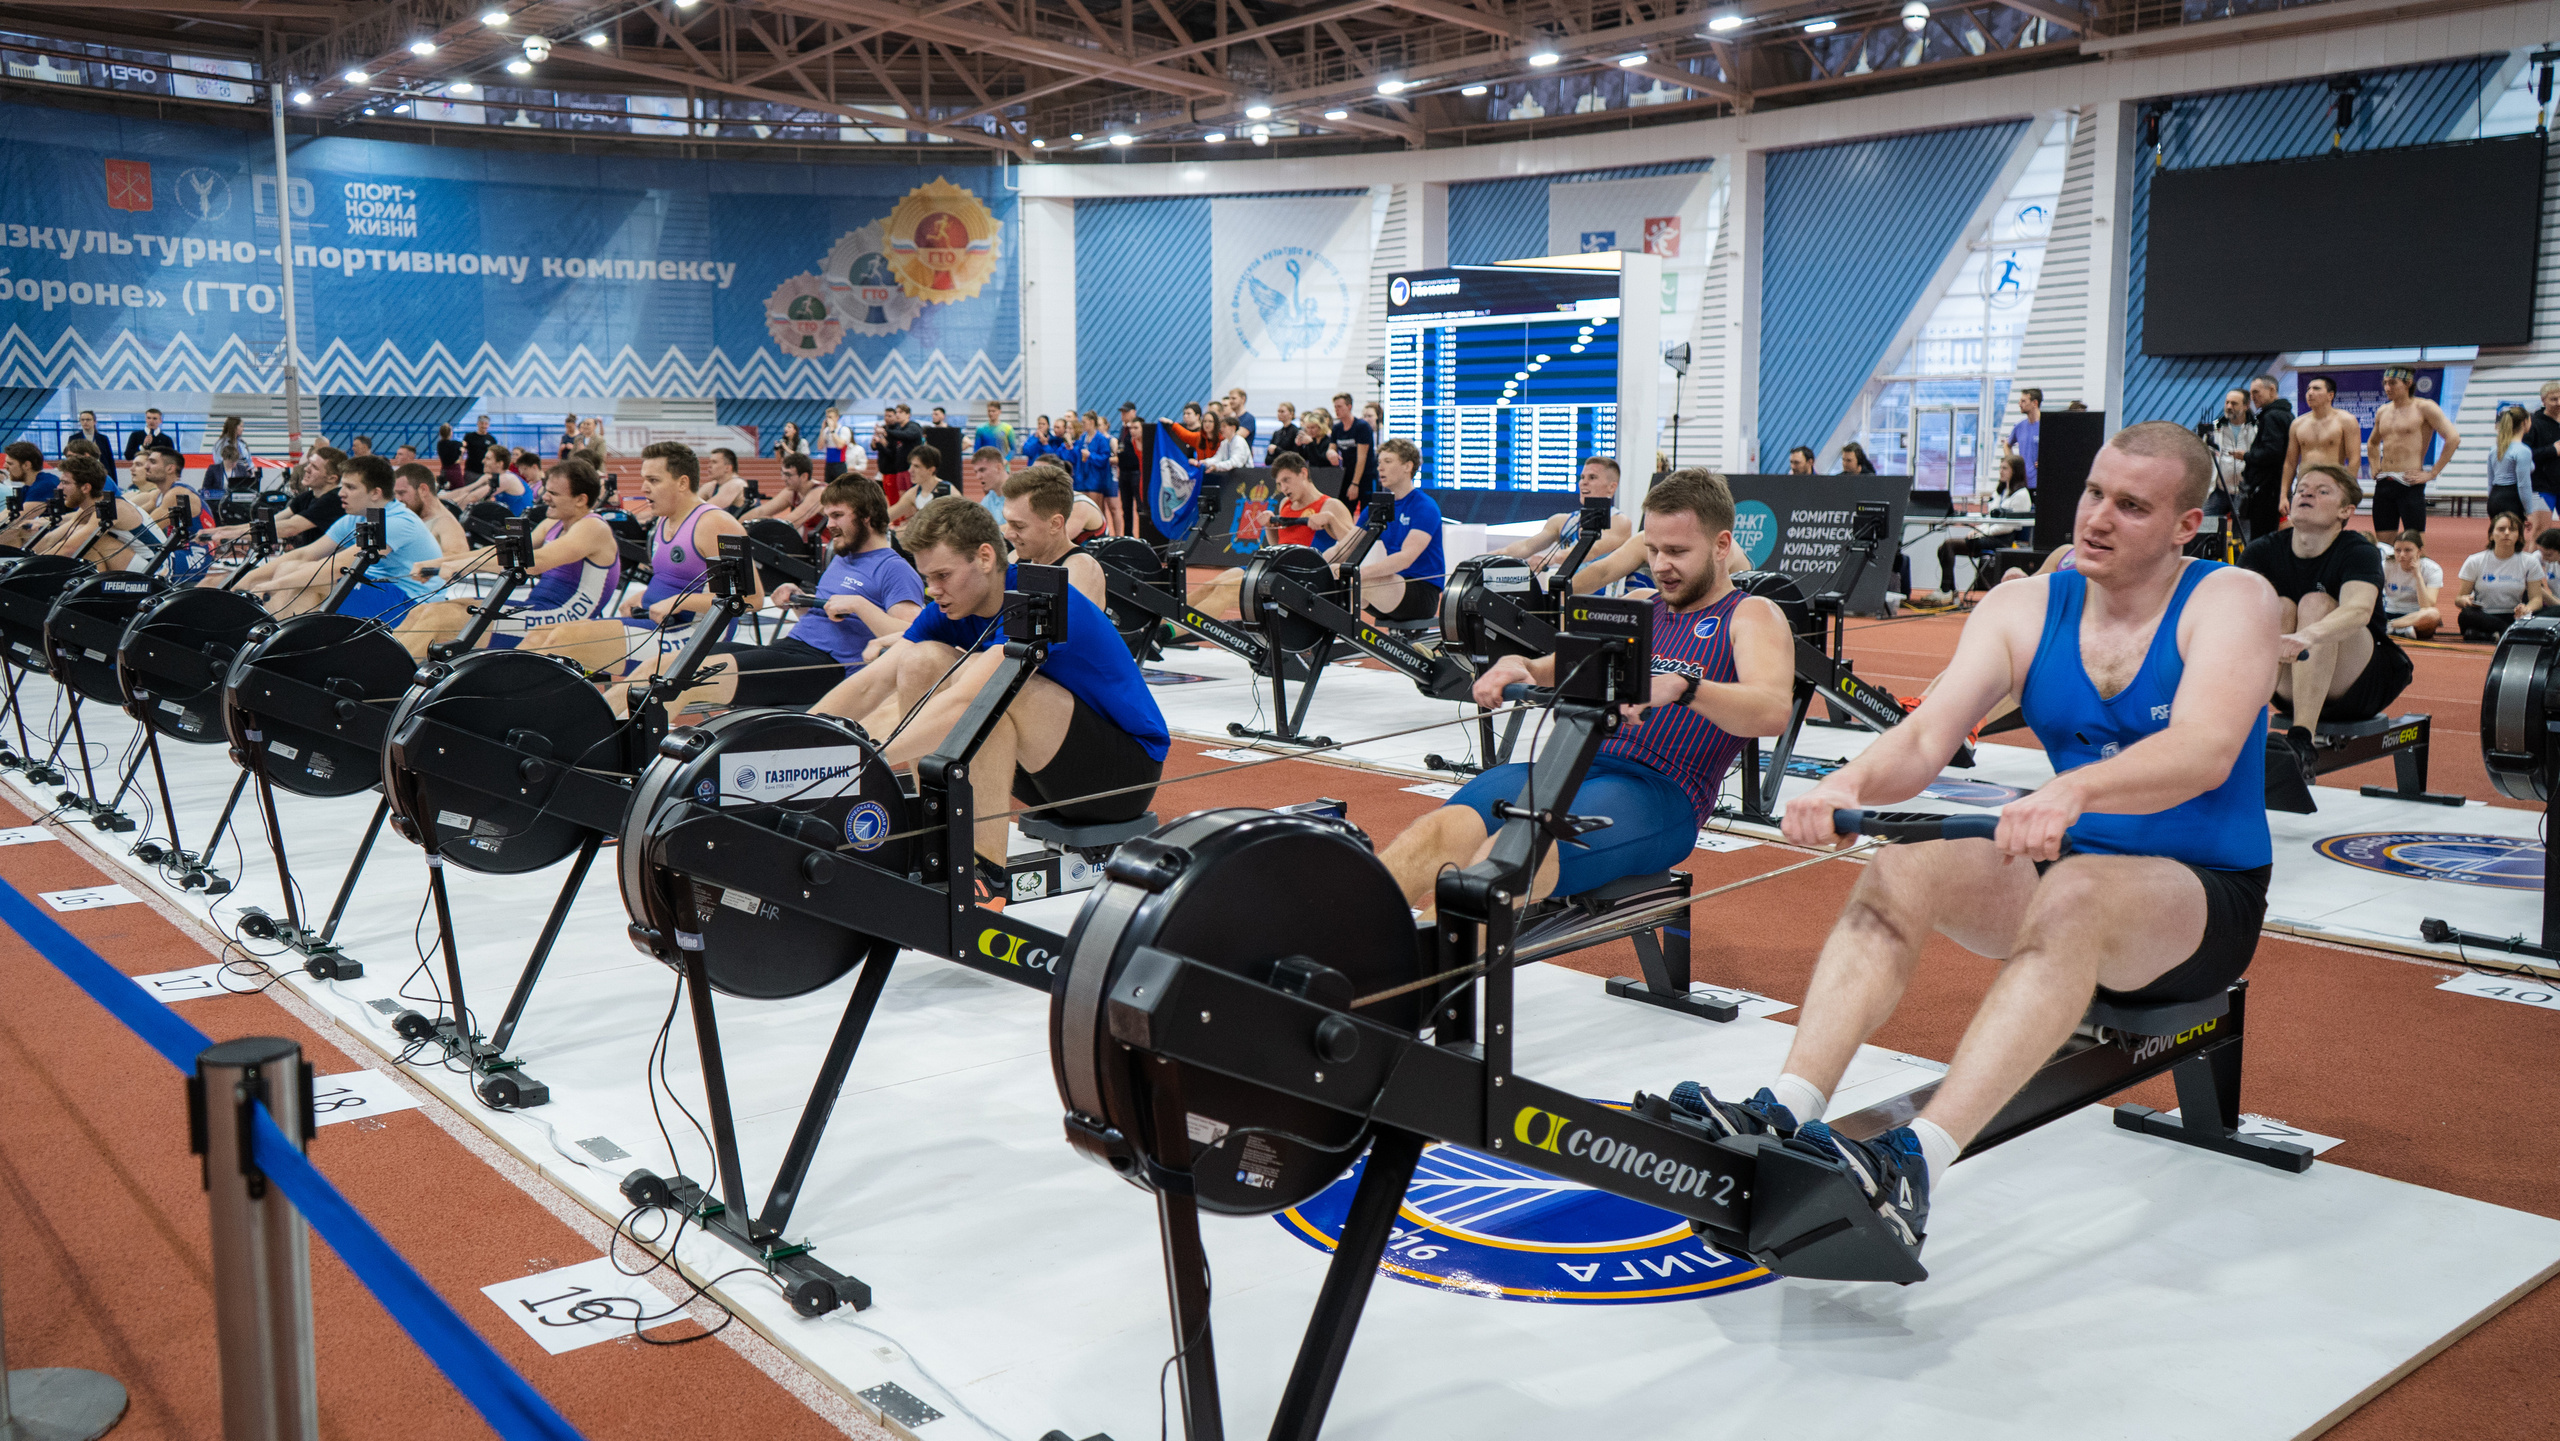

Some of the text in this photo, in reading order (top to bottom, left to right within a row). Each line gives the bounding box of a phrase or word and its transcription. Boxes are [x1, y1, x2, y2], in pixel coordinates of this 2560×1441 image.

[344, 182, 402, 202] СПОРТ
[345, 199, 417, 221] НОРМА
[347, 218, 418, 238] ЖИЗНИ
[0, 223, 737, 289] зкультурно-спортивному комплексу
[928, 251, 956, 264] ГТО
[861, 288, 889, 301] ГТО
[1790, 509, 1849, 523] КОМИТЕТ
[1786, 526, 1856, 541] ФИЗИЧЕСК
[1782, 542, 1842, 557] КУЛЬТУРЕ
[1779, 558, 1841, 574] И СПОРТУ
[104, 581, 149, 593] ГРЕБИ СЮДА!
[1588, 611, 1638, 624] concept 2
[1201, 619, 1258, 656] concept 2
[1376, 636, 1430, 673] concept 2
[1855, 689, 1901, 725] concept
[764, 765, 850, 784] ГАЗПРОМБАНК
[55, 892, 105, 906] 16
[759, 902, 780, 921] HR
[153, 974, 214, 992] 17
[2476, 986, 2554, 1003] 40
[1567, 1128, 1736, 1207] concept 2
[1556, 1245, 1733, 1283] ЛИГА
[518, 1285, 614, 1327] 19
